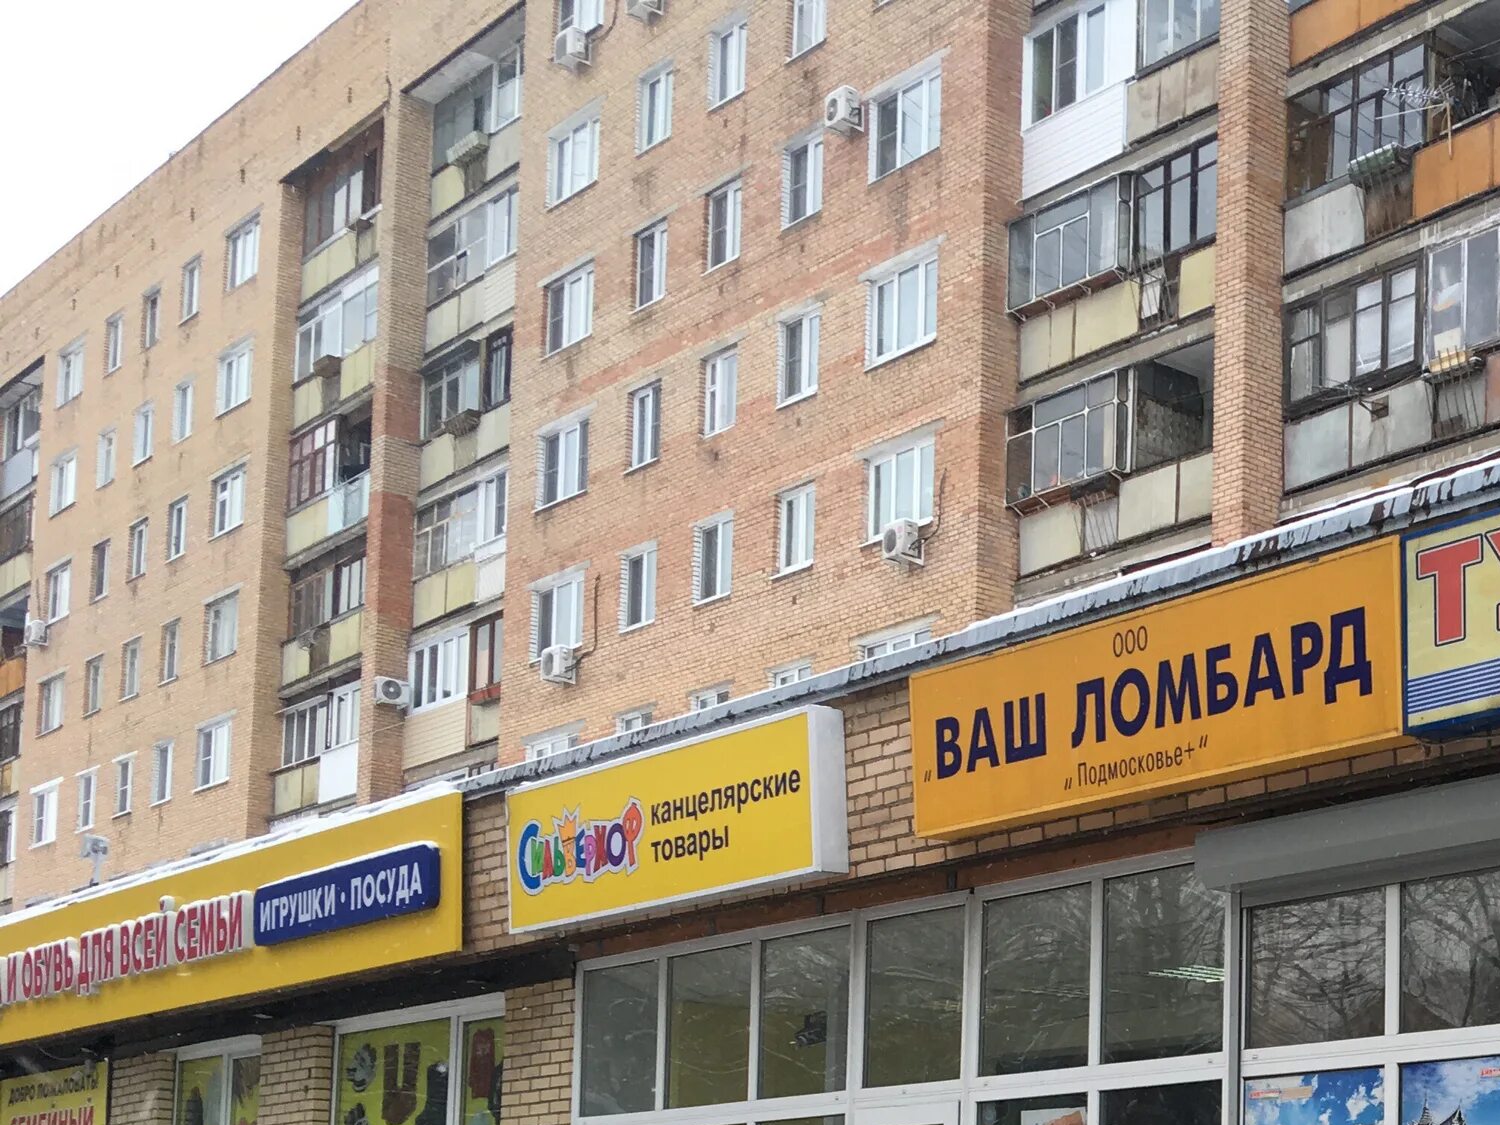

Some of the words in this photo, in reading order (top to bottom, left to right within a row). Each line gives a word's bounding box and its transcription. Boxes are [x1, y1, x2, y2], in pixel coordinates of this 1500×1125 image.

[1112, 625, 1148, 658] ООО
[1071, 606, 1373, 749] ЛОМБАРД
[651, 768, 801, 826] канцелярские
[651, 826, 730, 863] товары
[260, 884, 336, 933] ИГРУШКИ
[350, 862, 422, 910] ПОСУДА
[7, 955, 17, 1003] И
[22, 941, 74, 999] ОБУВЬ
[76, 929, 114, 996] ДЛЯ
[119, 900, 168, 976] ВСЕЙ
[174, 894, 243, 963] СЕМЬИ
